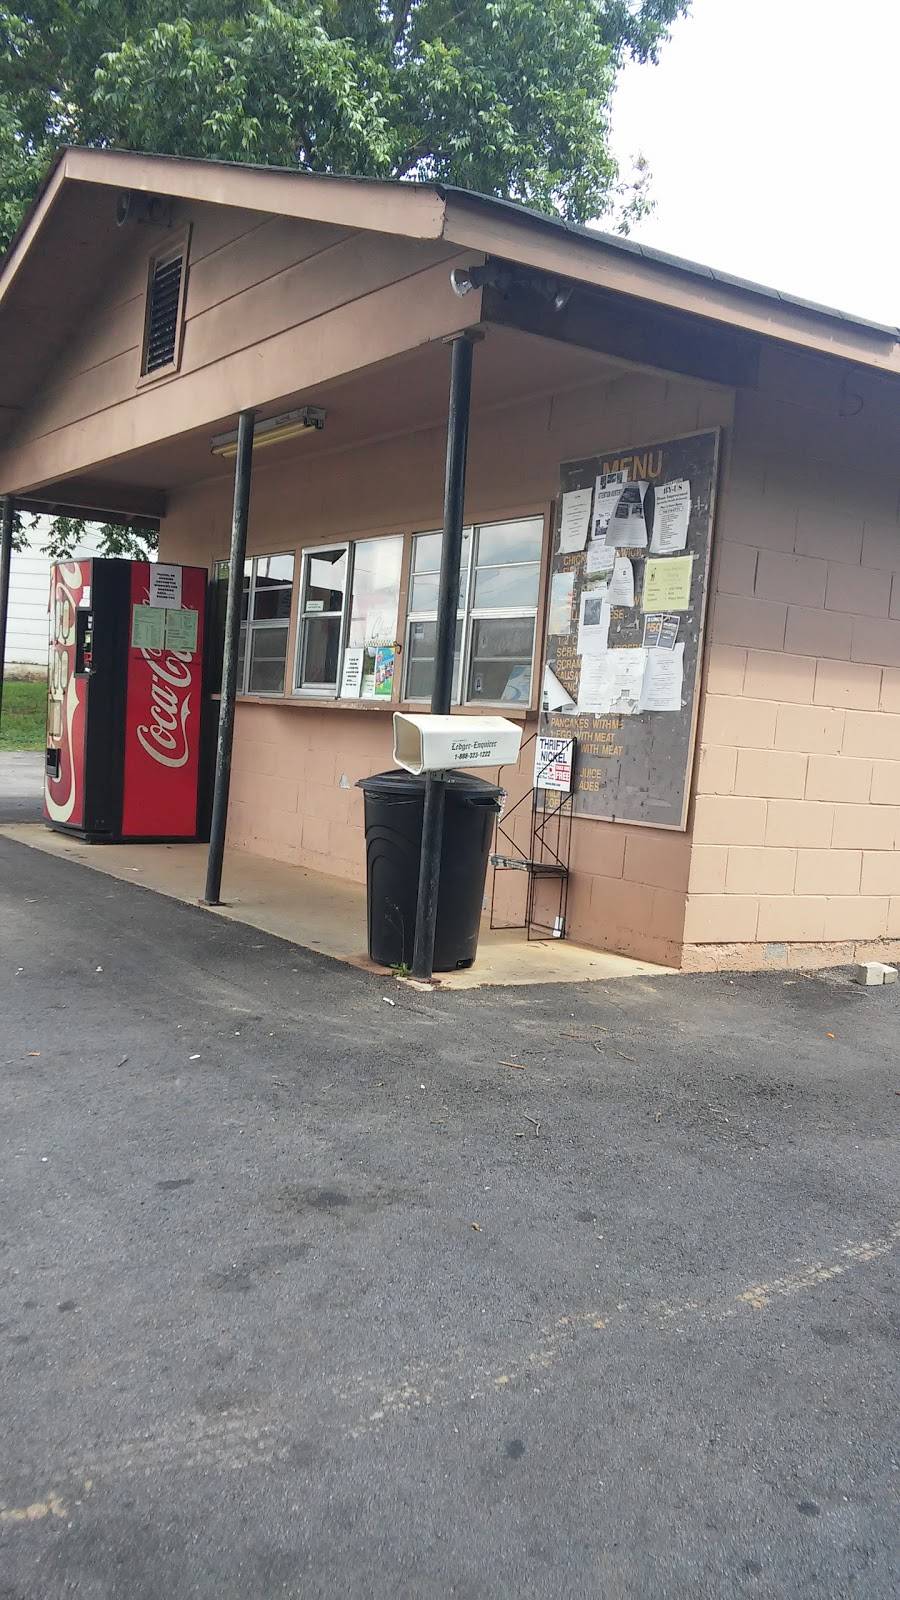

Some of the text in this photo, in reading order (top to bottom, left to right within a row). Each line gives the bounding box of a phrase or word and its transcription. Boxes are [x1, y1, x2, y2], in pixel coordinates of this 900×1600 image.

[603, 450, 662, 481] MENU
[556, 647, 577, 657] SCRA
[551, 717, 589, 728] PANCAKES
[594, 733, 615, 742] MEAT
[540, 738, 570, 751] THRIFTY
[581, 744, 624, 755] WITH MEAT
[540, 751, 568, 763] NICKEL
[580, 768, 602, 778] JUICE
